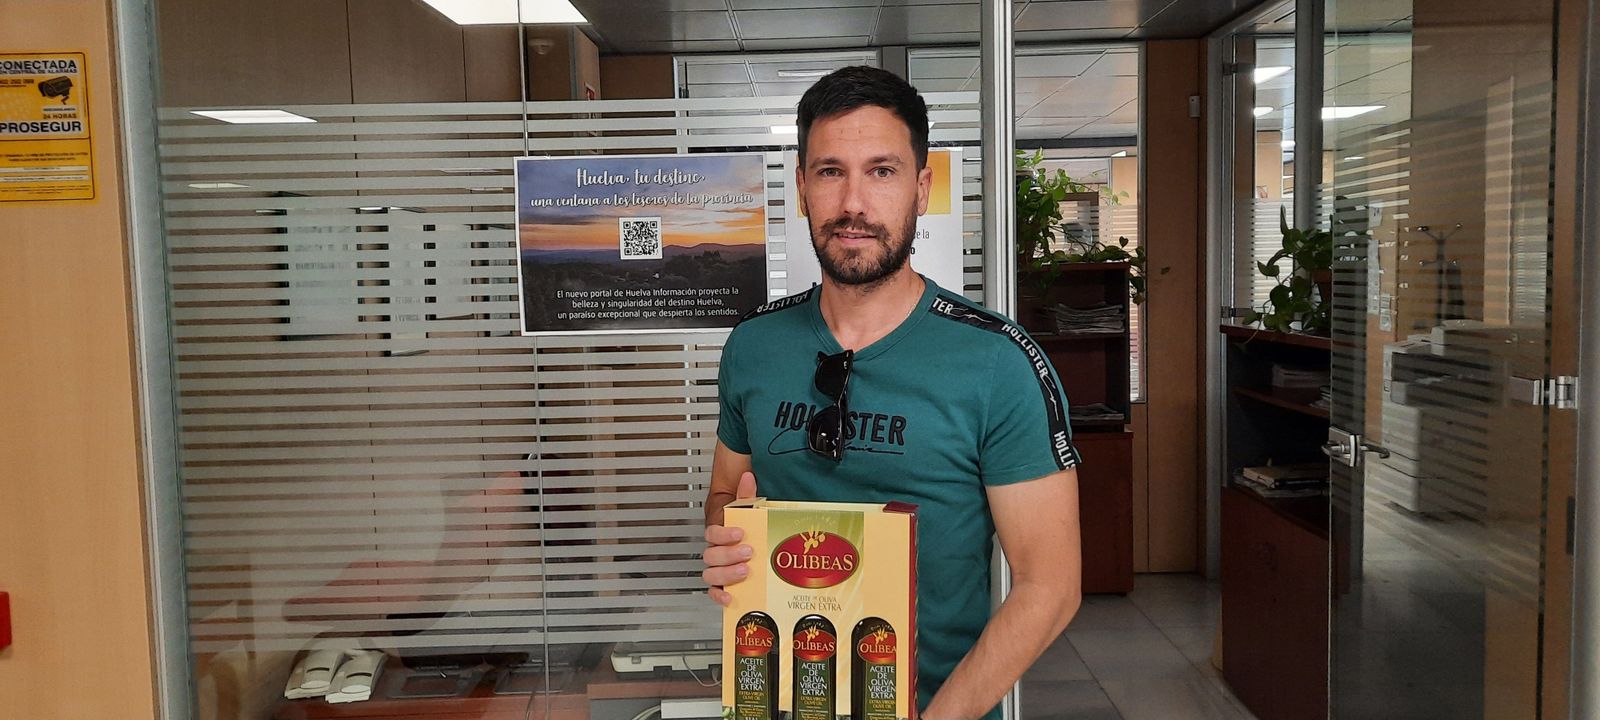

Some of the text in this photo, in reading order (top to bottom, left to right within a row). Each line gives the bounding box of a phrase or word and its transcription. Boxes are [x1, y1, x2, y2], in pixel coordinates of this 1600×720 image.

[0, 60, 76, 70] ONECTADA
[0, 121, 81, 133] PROSEGUR
[634, 168, 650, 185] tu
[530, 198, 554, 207] una
[556, 194, 600, 207] ventana
[604, 198, 612, 206] a
[614, 194, 630, 207] los
[632, 192, 668, 207] tesoros
[671, 192, 684, 205] de
[687, 192, 700, 205] la
[922, 229, 930, 239] la
[557, 286, 739, 299] El nuevo portal de Huelva Información proyecta la
[572, 298, 724, 310] belleza y singularidad del destino Huelva,
[569, 311, 596, 320] paraíso
[598, 310, 640, 320] excepcional
[642, 310, 656, 319] que
[658, 308, 692, 318] despierta
[694, 308, 705, 316] los
[708, 308, 740, 316] sentidos.
[1002, 324, 1049, 379] HOLLISTER
[774, 401, 906, 446] HOLSTER
[776, 552, 853, 571] OLIBEAS
[793, 594, 810, 602] ACEITE
[787, 601, 841, 611] VIRGEN EXTRA
[793, 640, 836, 652] OLIBEAS
[800, 682, 827, 690] VIRGEN
